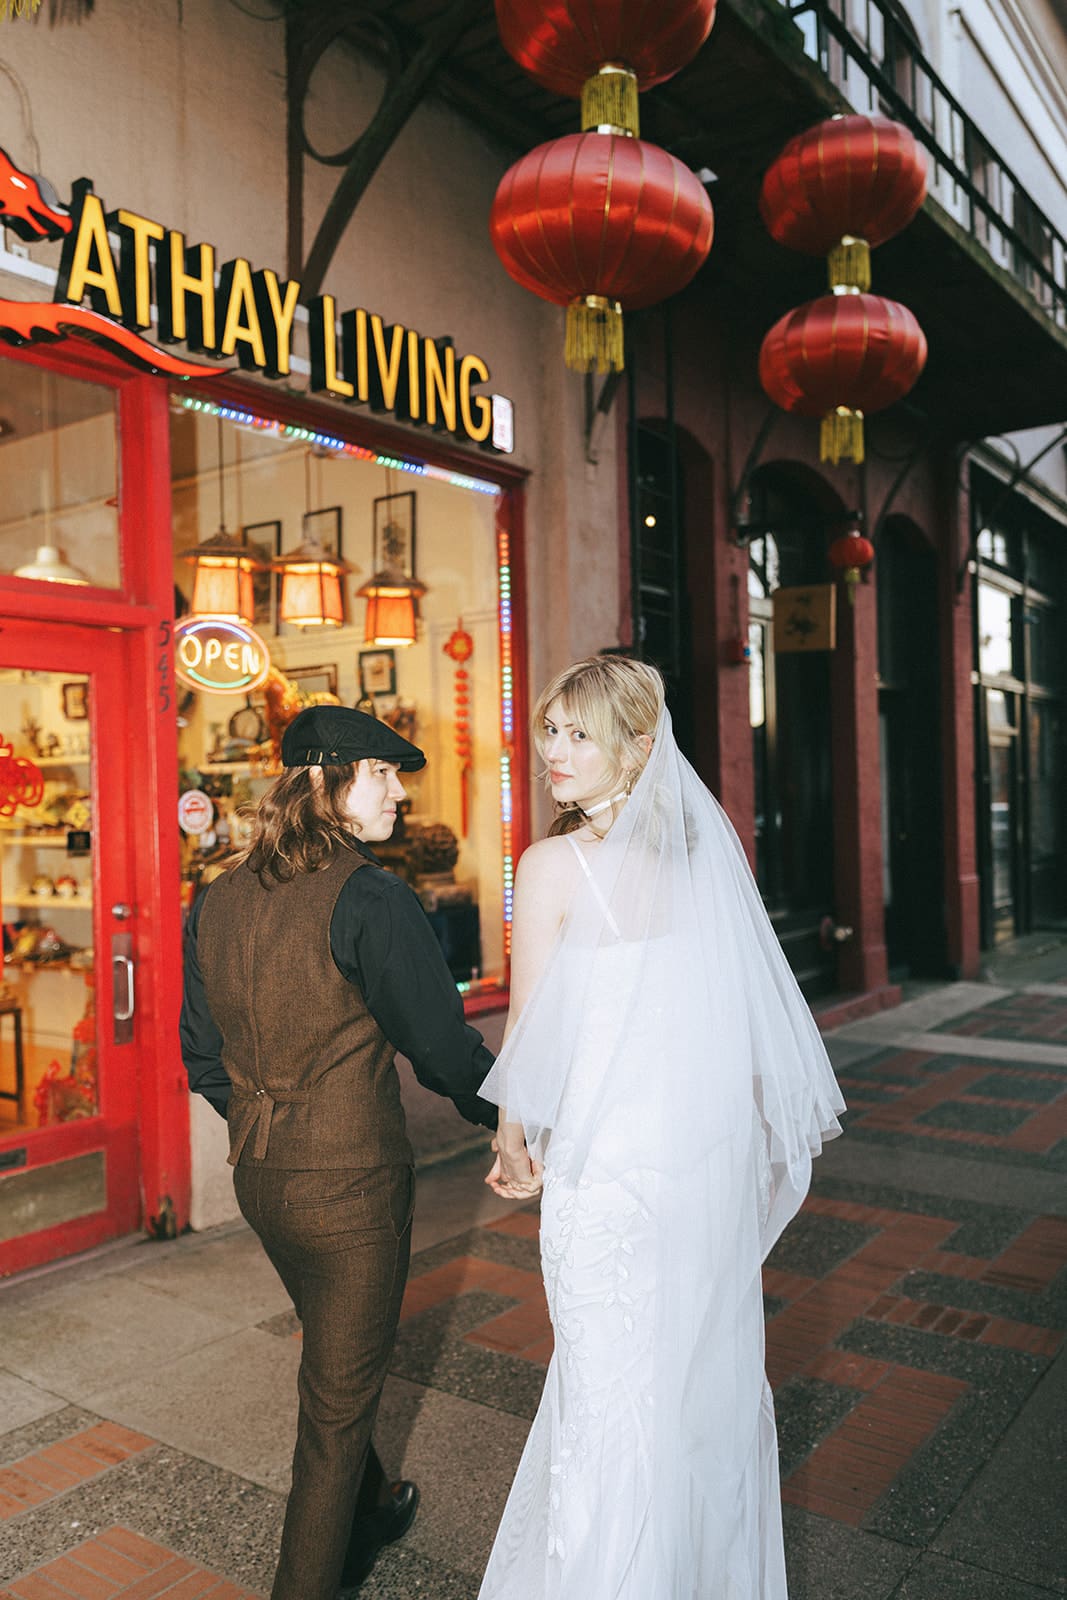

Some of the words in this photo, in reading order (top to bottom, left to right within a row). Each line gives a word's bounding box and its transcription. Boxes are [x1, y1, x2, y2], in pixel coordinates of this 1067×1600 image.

[66, 193, 301, 376] ATHAY
[322, 294, 494, 443] LIVING
[180, 634, 259, 675] OPEN
